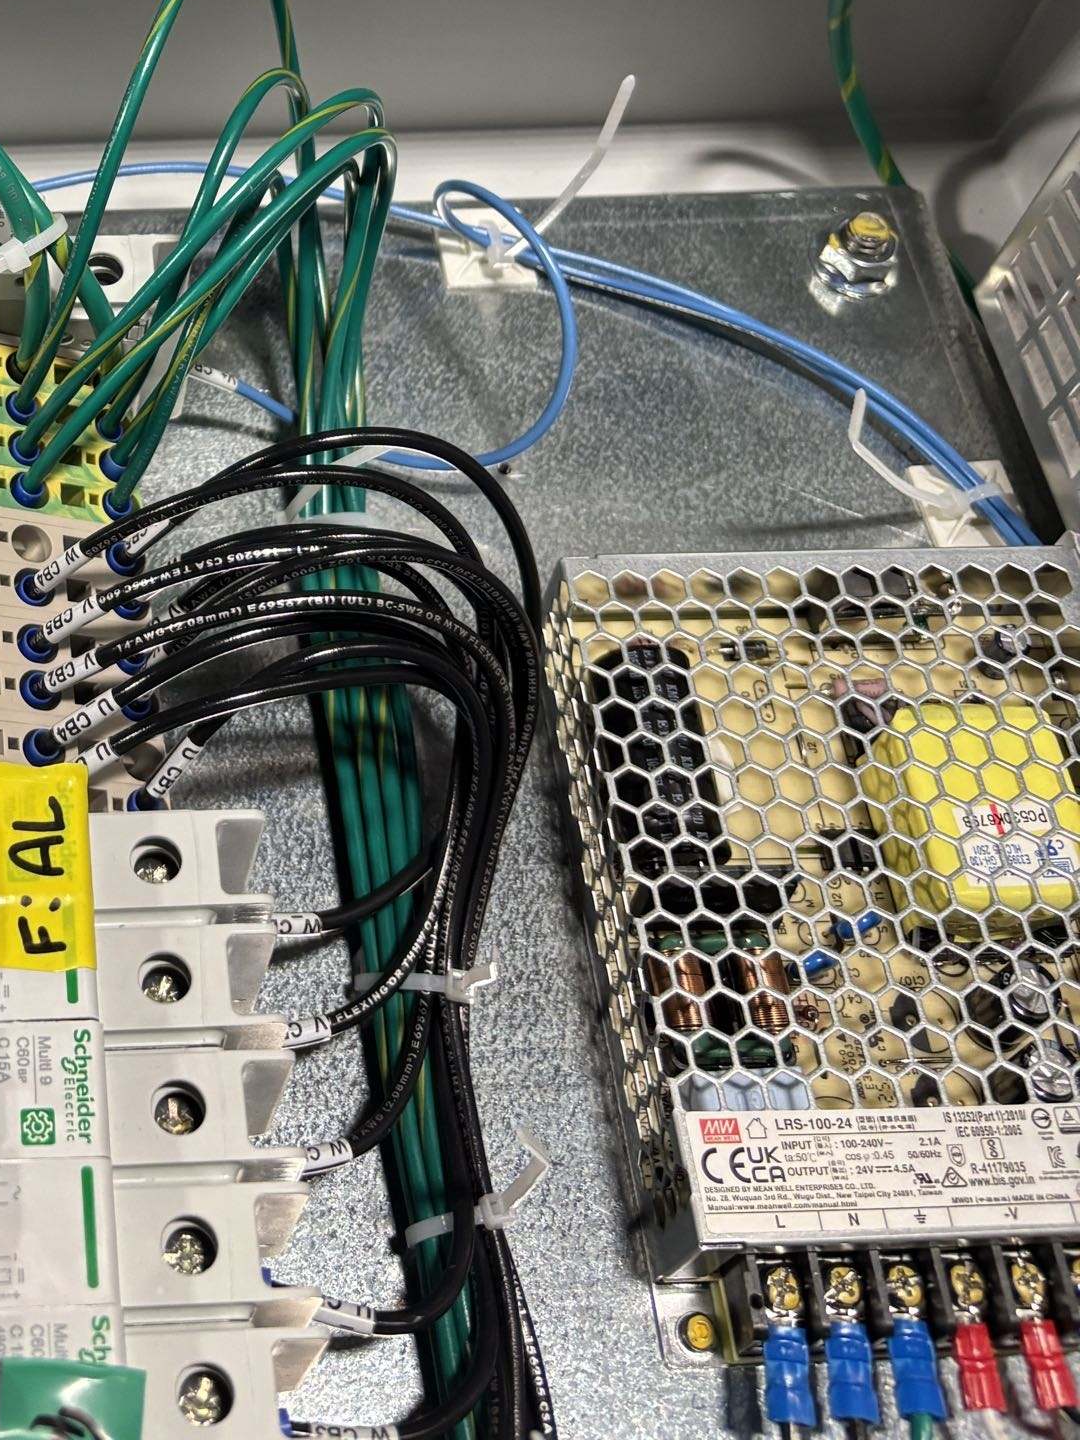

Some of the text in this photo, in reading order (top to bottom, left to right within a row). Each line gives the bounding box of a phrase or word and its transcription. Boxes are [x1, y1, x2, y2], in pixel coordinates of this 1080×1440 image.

[36, 547, 78, 584] W CB4
[196, 556, 223, 569] CSA
[159, 564, 189, 580] TEW
[45, 596, 94, 636] V CB5
[134, 626, 167, 646] AWG
[340, 596, 372, 609] (UL)
[425, 611, 443, 626] OR
[442, 616, 469, 638] MTW
[46, 653, 96, 688] V CB2
[55, 696, 112, 743] U CB4
[94, 743, 111, 761] U
[182, 745, 200, 760] U
[8, 796, 66, 876] AL
[334, 984, 388, 1026] FLEXING
[40, 1075, 52, 1086] 9
[73, 1029, 96, 1144] Schneider
[63, 1077, 76, 1142] Electric
[704, 1121, 735, 1135] MW
[775, 1118, 852, 1131] LRS-100-24
[955, 1127, 970, 1137] IEC
[330, 1137, 348, 1157] W
[781, 1141, 811, 1150] INPUT
[919, 1138, 941, 1146] 2.1A
[747, 1147, 783, 1163] UK
[752, 1166, 787, 1182] CA
[788, 1166, 828, 1177] OUTPUT
[856, 1164, 874, 1174] 24V
[894, 1163, 915, 1172] 4.5A
[775, 1207, 1018, 1228] L N -V
